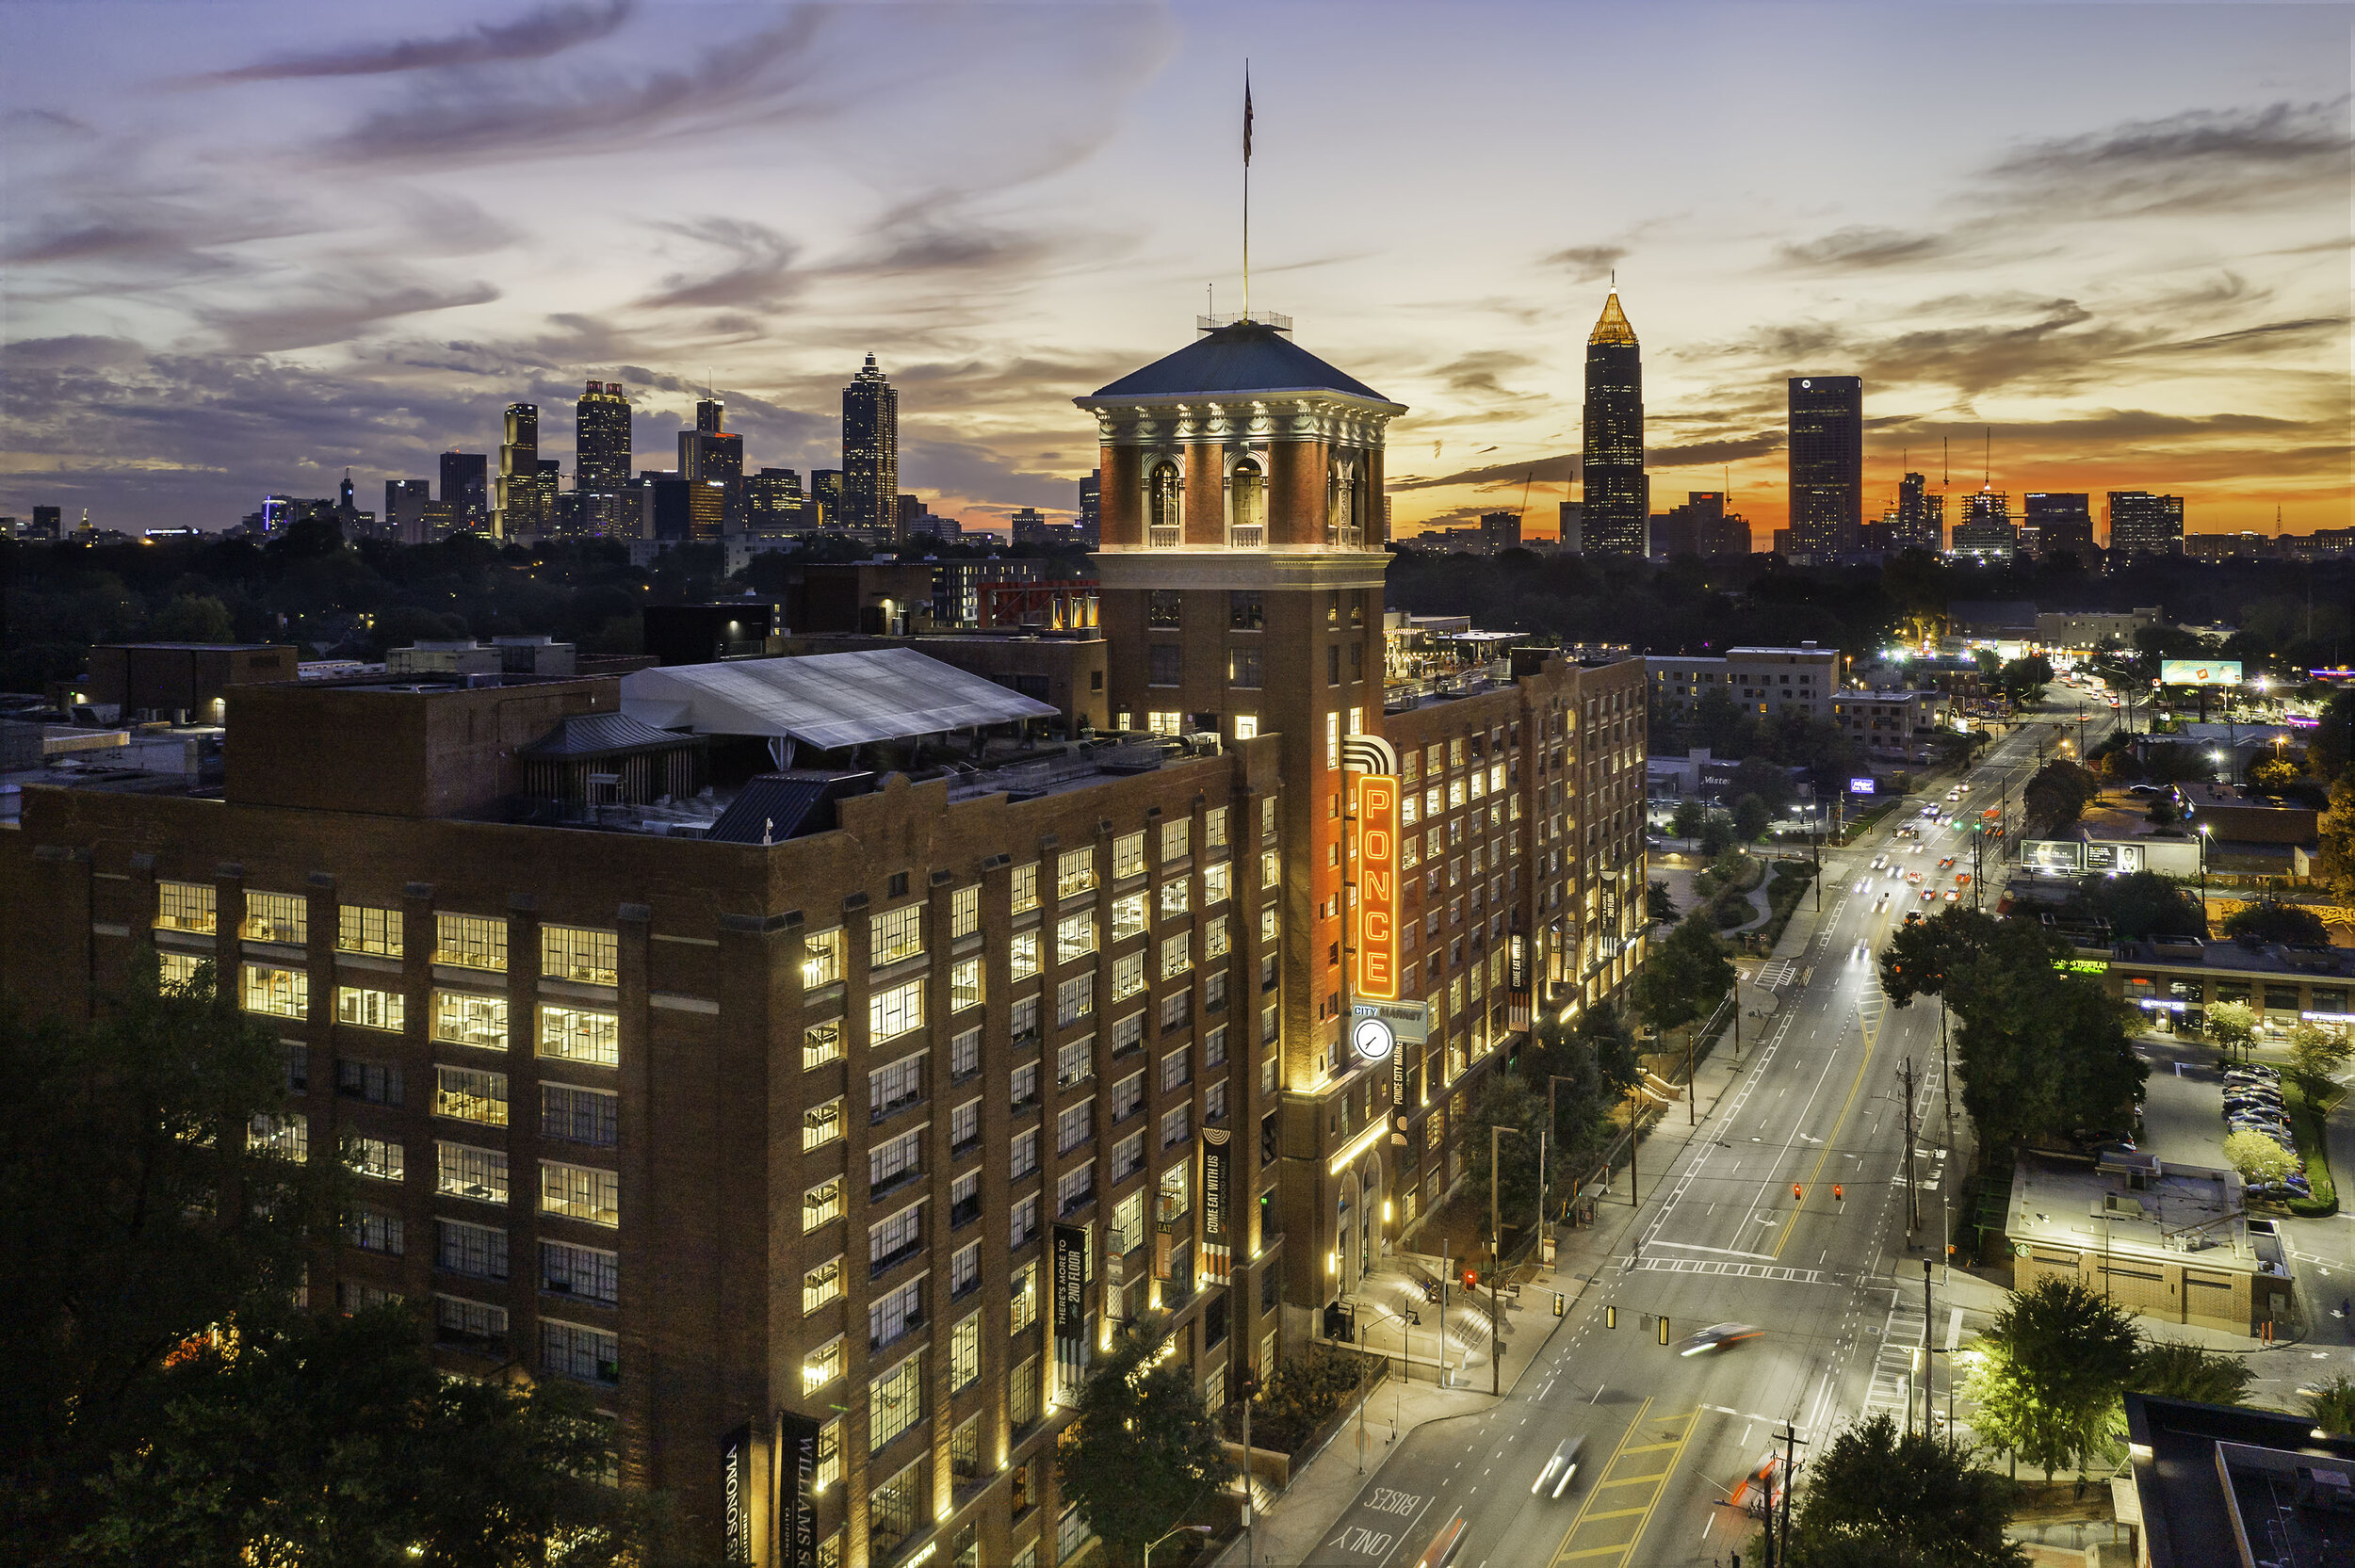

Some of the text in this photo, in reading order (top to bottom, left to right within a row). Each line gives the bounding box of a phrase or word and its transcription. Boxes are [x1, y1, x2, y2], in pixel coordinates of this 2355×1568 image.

[1365, 789, 1389, 982] PONCE
[1512, 935, 1520, 987] COME EAT WITH US
[1354, 1005, 1422, 1022] CITY MARKET
[1394, 1042, 1403, 1106] PONCE CITY MARKE
[1207, 1155, 1218, 1234] COME EAT WITH US
[1059, 1239, 1066, 1252] TO
[1158, 1223, 1172, 1233] EAT
[1068, 1251, 1080, 1303] 2ND FLOOR
[725, 1443, 739, 1537] SONOMA
[797, 1436, 813, 1545] WILLIAMS
[1364, 1488, 1421, 1516] BUSES
[1328, 1527, 1392, 1556] ONLY
